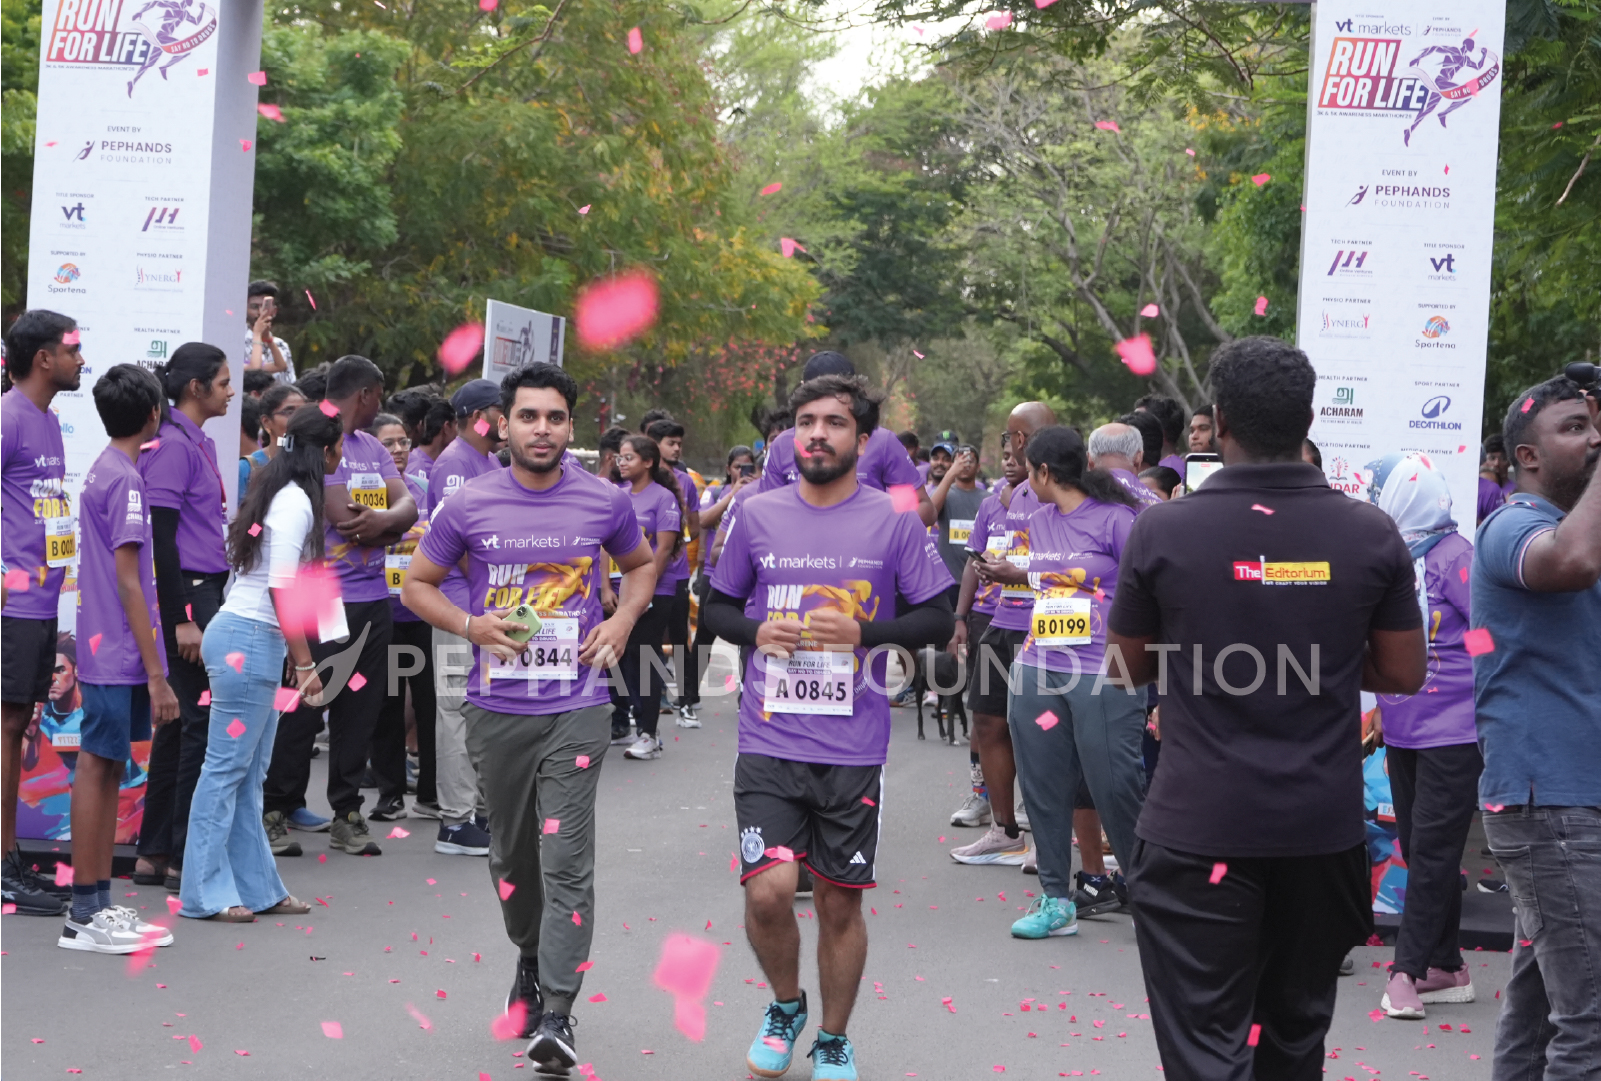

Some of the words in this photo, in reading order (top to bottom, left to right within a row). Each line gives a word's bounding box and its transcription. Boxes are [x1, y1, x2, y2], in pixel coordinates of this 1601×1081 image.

[57, 0, 122, 31] RUN
[1358, 22, 1412, 36] markets
[50, 33, 98, 62] FOR
[99, 34, 150, 64] LIFE
[1330, 40, 1397, 76] RUN
[1322, 76, 1371, 107] FOR
[1374, 78, 1426, 109] LIFE
[101, 141, 172, 153] PEPHANDS
[100, 155, 172, 164] FOUNDATION
[1376, 185, 1450, 198] PEPHANDS
[1375, 200, 1450, 209] FOUNDATION
[48, 284, 86, 295] Sportena
[1415, 340, 1456, 349] Sportena
[137, 360, 164, 369] ACHAR
[1320, 406, 1363, 418] ACHARAM
[1409, 420, 1462, 431] DECATHLON
[364, 494, 384, 506] 0036
[34, 499, 60, 518] FOR
[52, 541, 58, 556] B
[481, 534, 500, 549] vt
[504, 535, 560, 548] markets
[760, 553, 776, 569] vt
[779, 554, 836, 569] markets
[393, 573, 400, 585] B
[488, 564, 528, 586] RUN
[1235, 566, 1261, 578] The
[1265, 567, 1325, 578] Editorium
[484, 588, 522, 608] FOR
[767, 585, 804, 609] RUN
[1038, 620, 1045, 634] B
[1049, 618, 1085, 634] 0199
[520, 648, 572, 667] 0844
[776, 679, 789, 698] A
[795, 680, 846, 701] 0845
